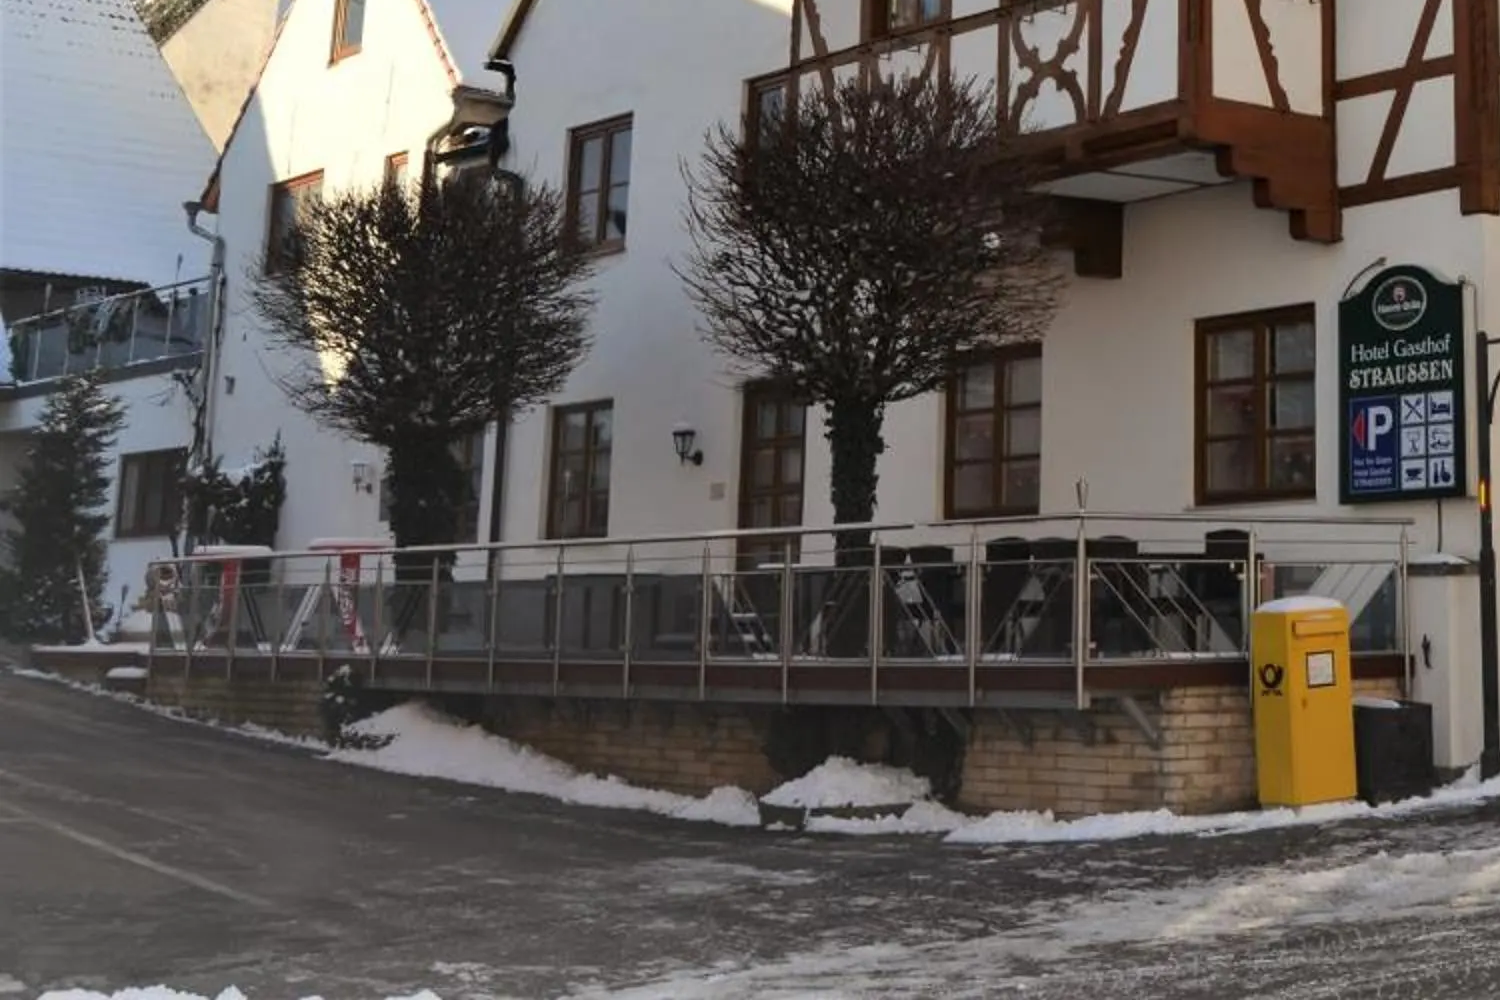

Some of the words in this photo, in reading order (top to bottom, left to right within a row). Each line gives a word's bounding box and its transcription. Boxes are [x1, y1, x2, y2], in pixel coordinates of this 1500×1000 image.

[1351, 340, 1389, 362] Hotel
[1393, 333, 1451, 357] Gasthof
[1349, 359, 1453, 389] STRAUSSEN
[1367, 405, 1393, 451] P
